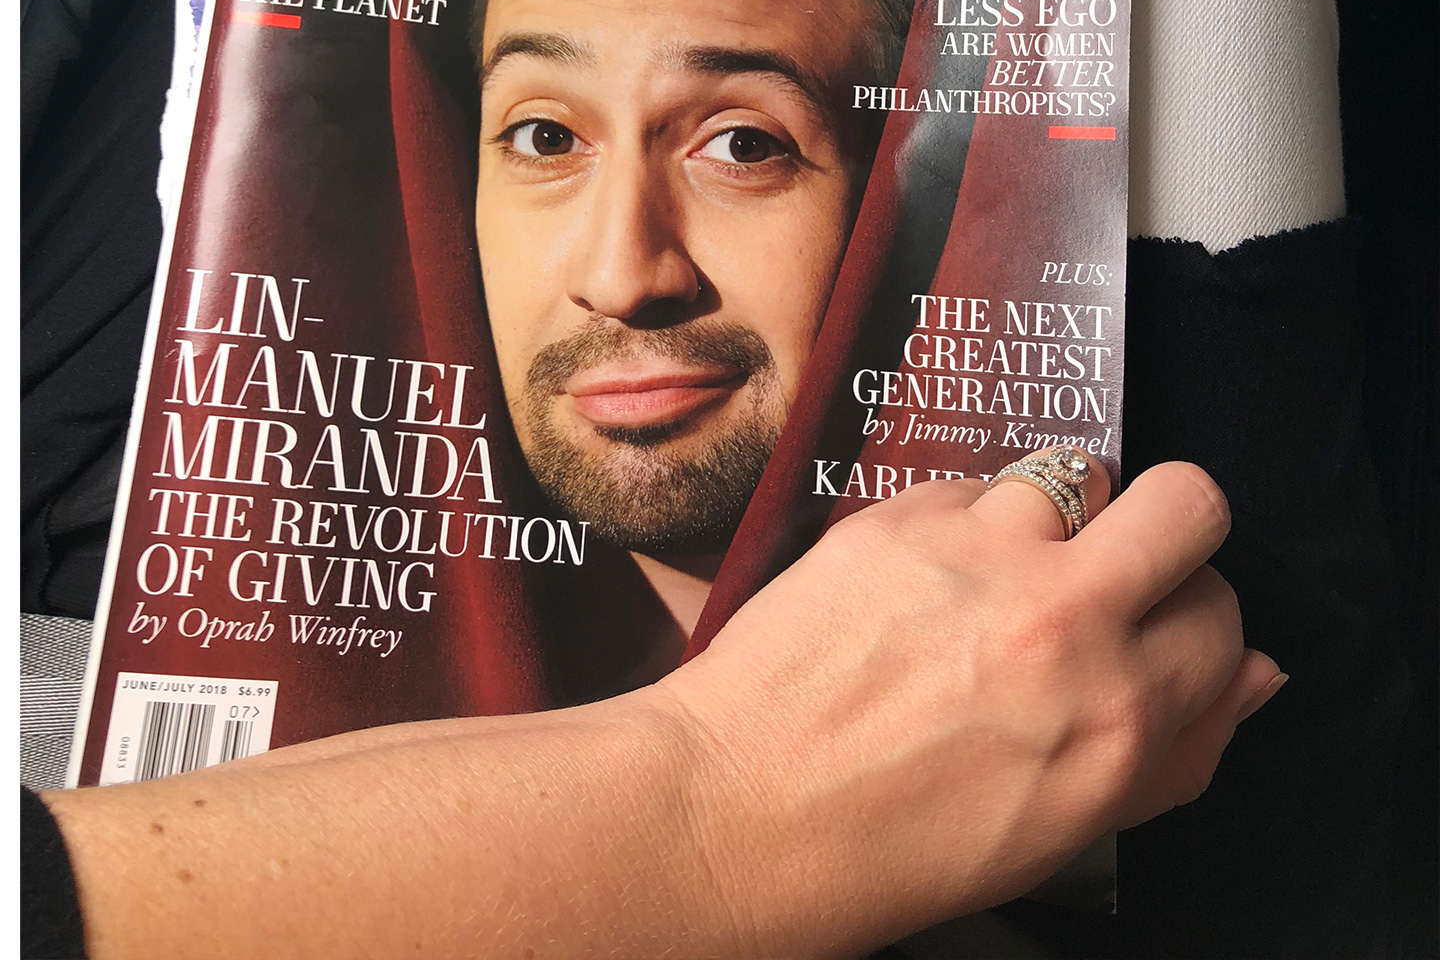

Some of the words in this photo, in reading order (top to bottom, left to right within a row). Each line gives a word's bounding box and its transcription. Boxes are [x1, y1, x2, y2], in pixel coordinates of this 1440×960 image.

[940, 32, 998, 56] ARE
[1006, 32, 1115, 57] WOMEN
[989, 60, 1114, 88] BETTER
[851, 85, 1116, 117] PHILANTHROPISTS?
[1040, 261, 1113, 286] PLUS:
[176, 268, 324, 342] LIN-
[911, 294, 991, 333] THE
[1003, 300, 1112, 340] NEXT
[903, 333, 1111, 382] GREATEST
[164, 338, 487, 431] MANUEL
[852, 369, 1110, 424] GENERATION
[862, 408, 895, 445] by
[898, 413, 992, 453] Jimmy
[152, 410, 503, 504] MIRANDA
[148, 488, 253, 541] THE
[265, 497, 591, 566] REVOLUTION
[136, 543, 213, 597] OF
[228, 549, 438, 613] GIVING
[127, 602, 167, 644] by
[177, 607, 276, 649] Oprah
[288, 614, 403, 658] Winfrey
[121, 679, 196, 694] JUNE/JULY
[199, 684, 227, 695] 2018
[238, 686, 271, 697] $6.99
[116, 736, 131, 770] 08833
